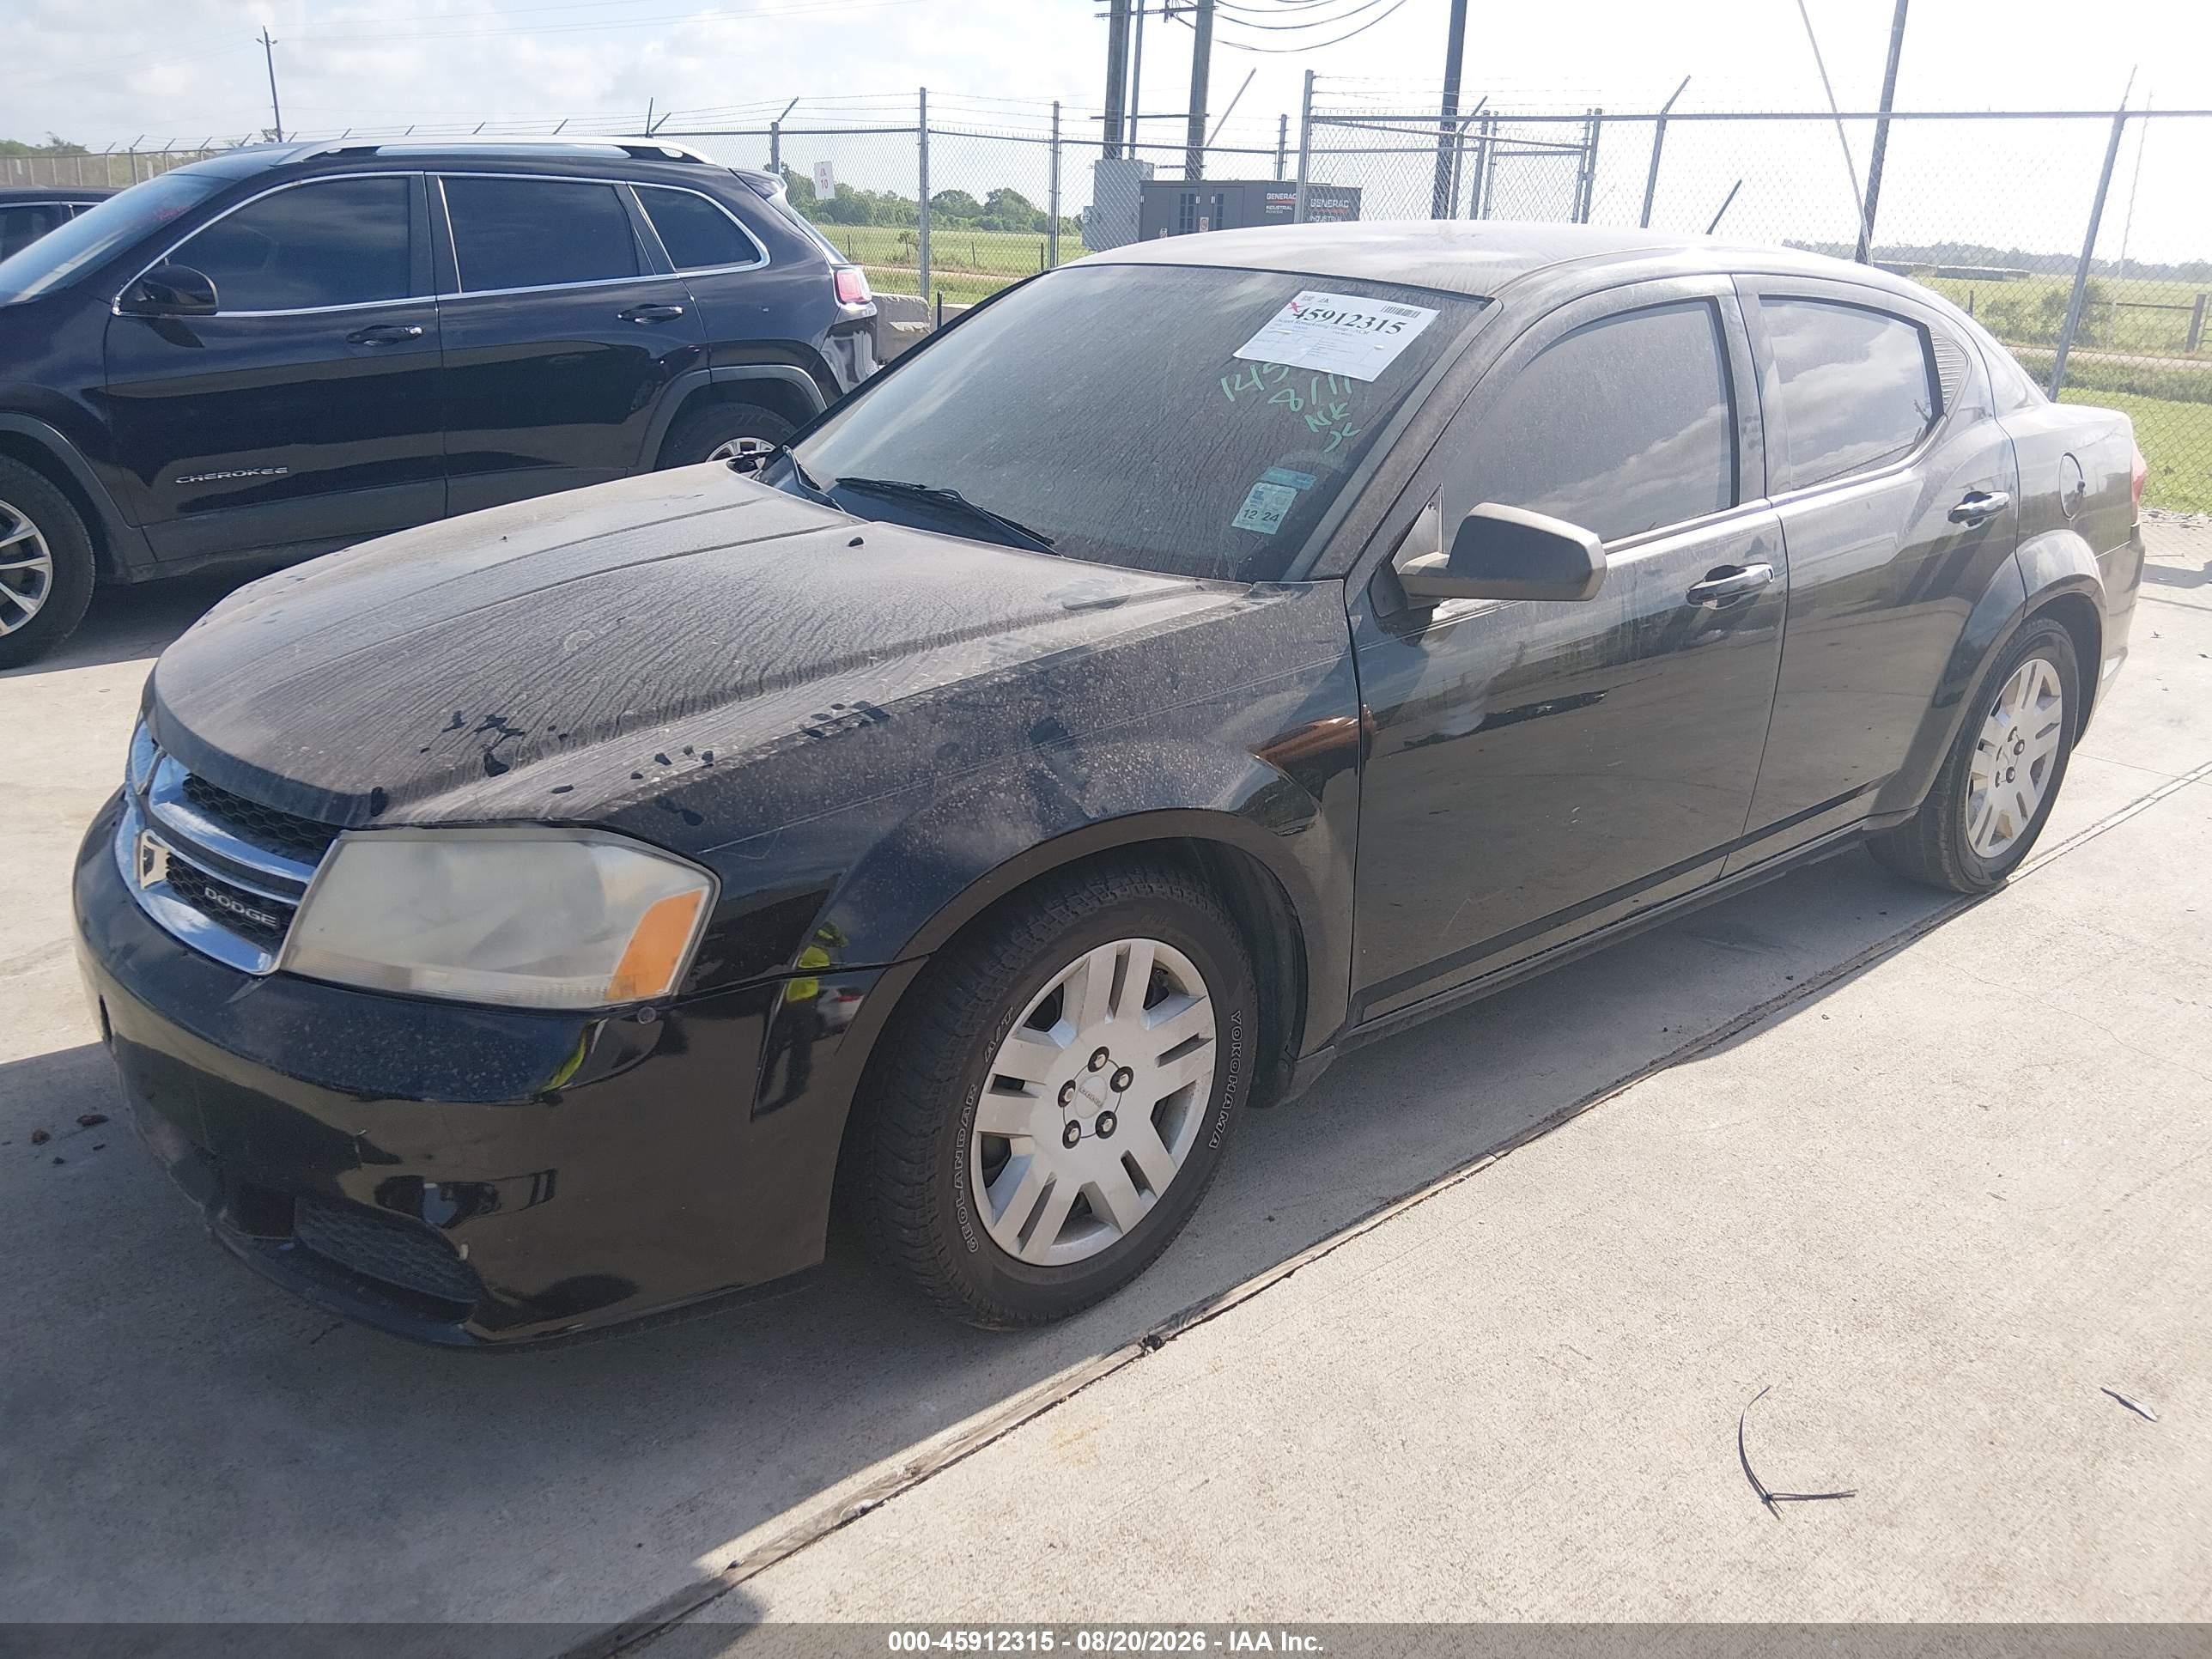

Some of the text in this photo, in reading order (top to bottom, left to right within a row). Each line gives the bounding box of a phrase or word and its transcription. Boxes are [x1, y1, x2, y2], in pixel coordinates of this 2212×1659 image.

[1310, 198, 1349, 208] GENERAC
[1292, 307, 1408, 336] 45912315
[175, 466, 289, 483] CHEROKEE
[1243, 508, 1280, 522] 12 24
[204, 886, 277, 927] DODGE
[1207, 1009, 1243, 1151] YOKOHAMA
[954, 1084, 979, 1254] GEOLANDAR
